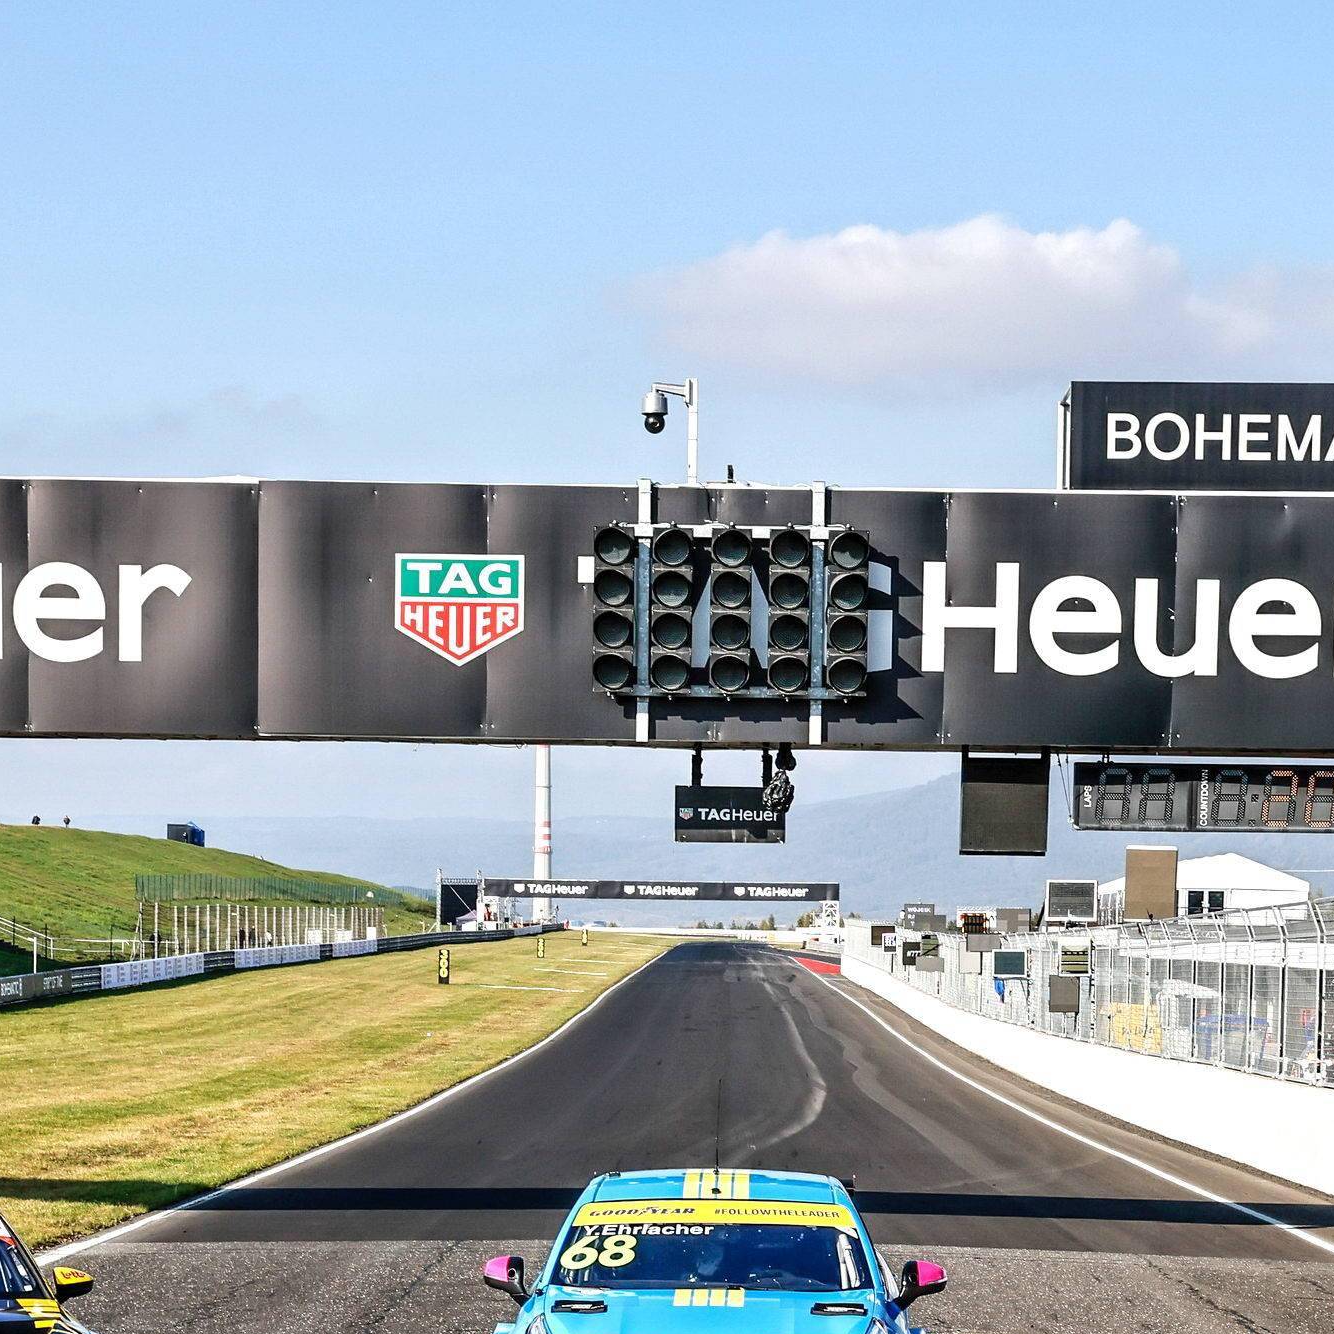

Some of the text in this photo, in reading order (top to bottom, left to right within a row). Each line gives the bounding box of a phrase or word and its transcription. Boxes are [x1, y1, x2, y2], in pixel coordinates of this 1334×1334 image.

[406, 562, 512, 595] TAG
[402, 604, 516, 651] HEUER
[1084, 785, 1093, 808] LAPS
[1199, 769, 1209, 827] COUNTDOWN
[439, 949, 449, 977] 300
[714, 1207, 840, 1219] #FOLLOWTHELEADER
[583, 1224, 715, 1237] Y.Ehrlacher
[559, 1234, 638, 1270] 68
